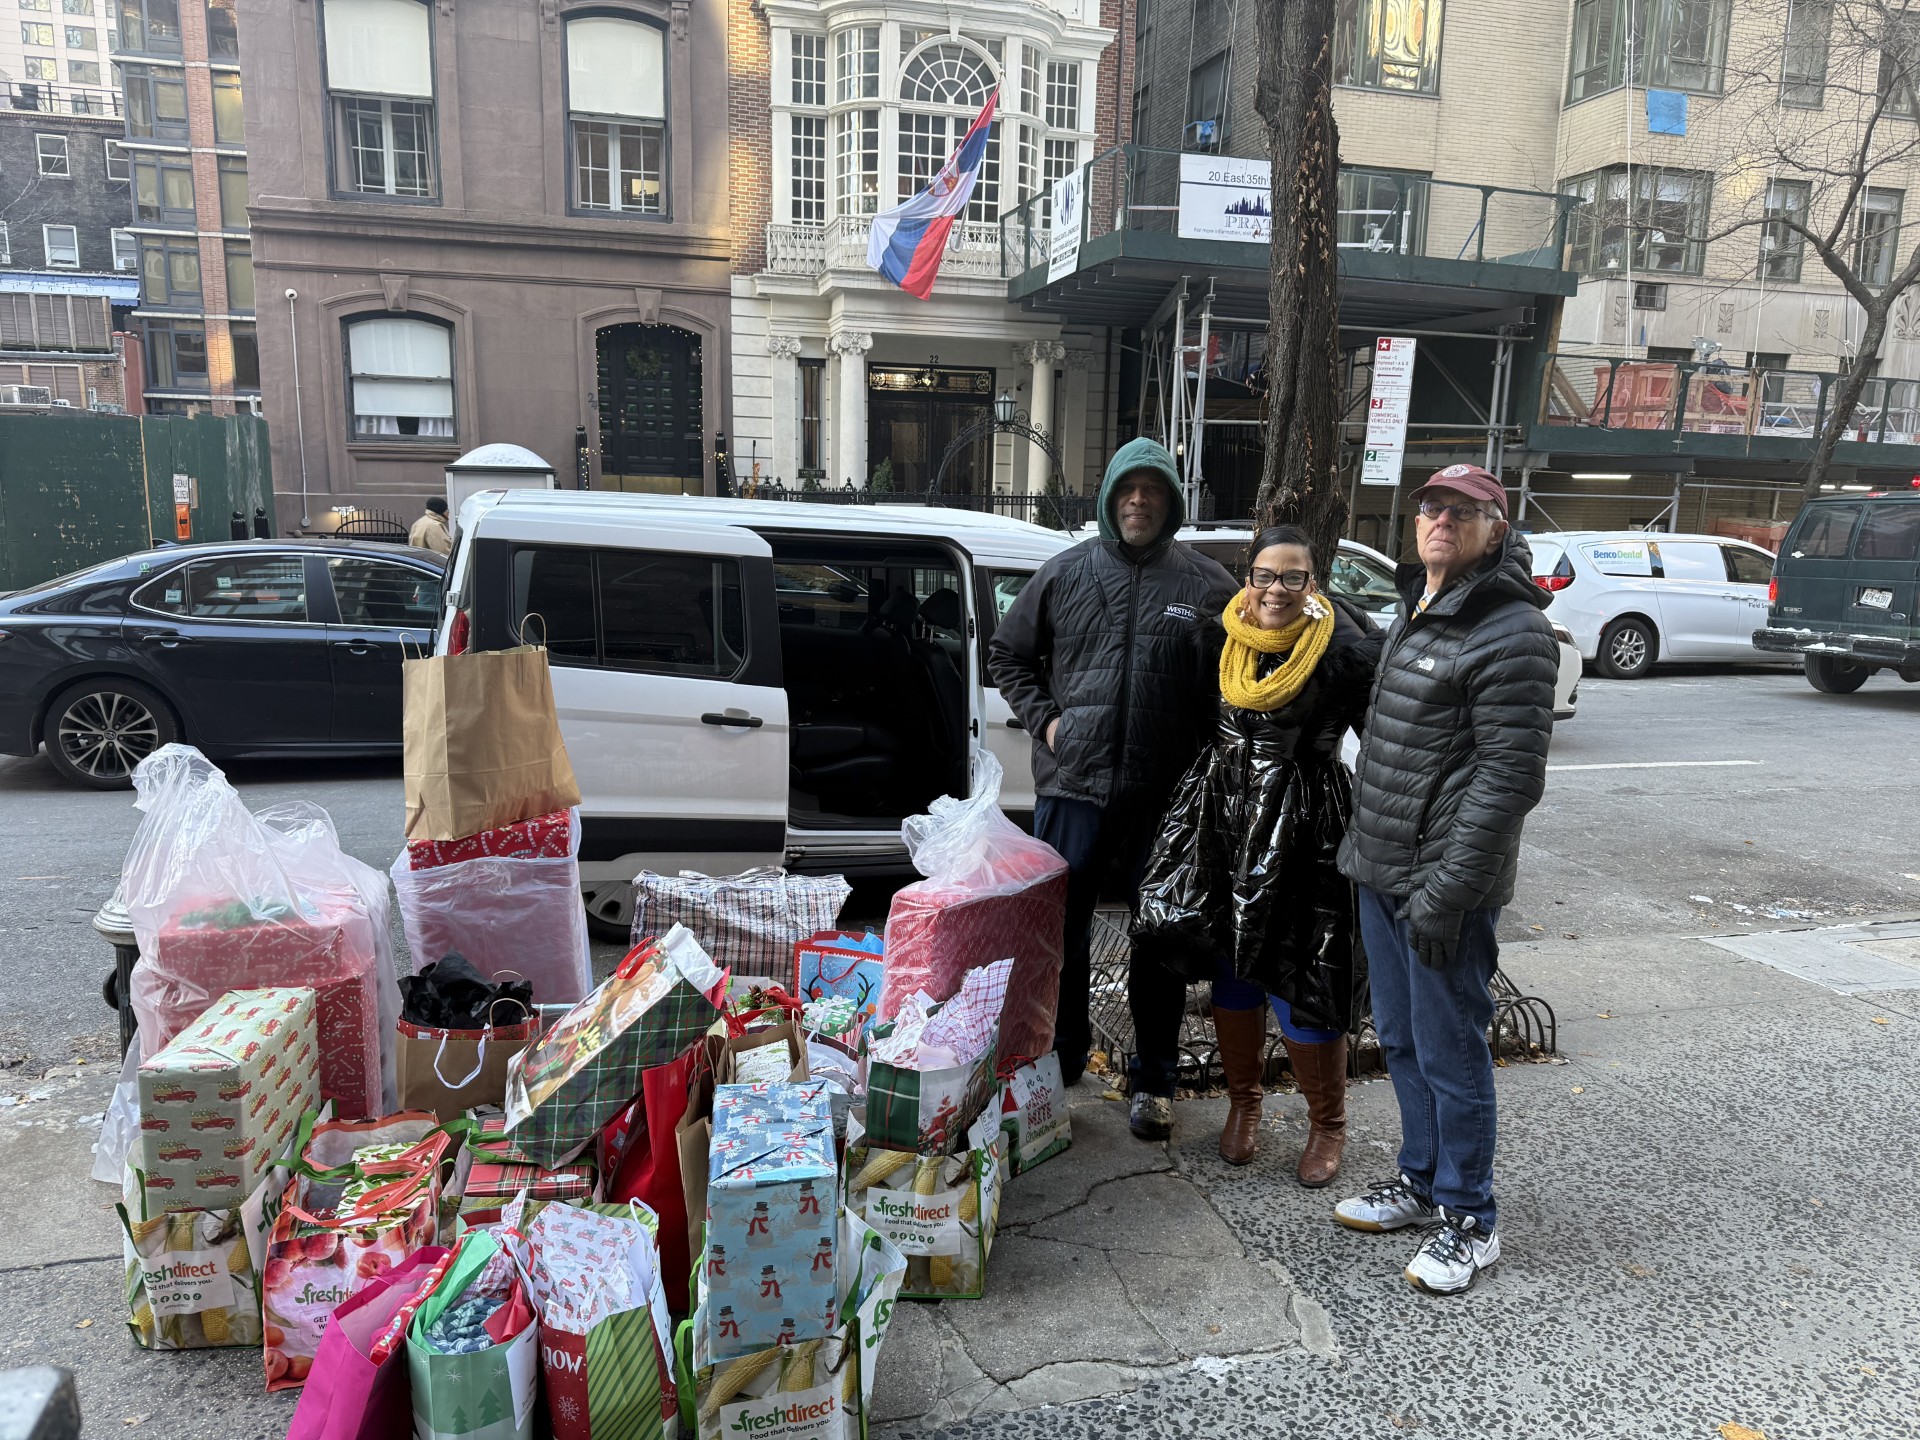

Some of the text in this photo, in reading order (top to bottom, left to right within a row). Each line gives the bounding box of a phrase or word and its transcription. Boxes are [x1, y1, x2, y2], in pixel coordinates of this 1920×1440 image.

[1208, 171, 1267, 185] 20 East 35th
[929, 354, 939, 364] 22
[1367, 450, 1375, 461] 2
[879, 1196, 950, 1220] freshdirect
[158, 1281, 173, 1290] that
[313, 1315, 328, 1323] GET
[738, 1395, 836, 1432] freshdirect
[749, 1431, 769, 1440] Food
[770, 1426, 785, 1436] that
[786, 1423, 815, 1433] delivers
